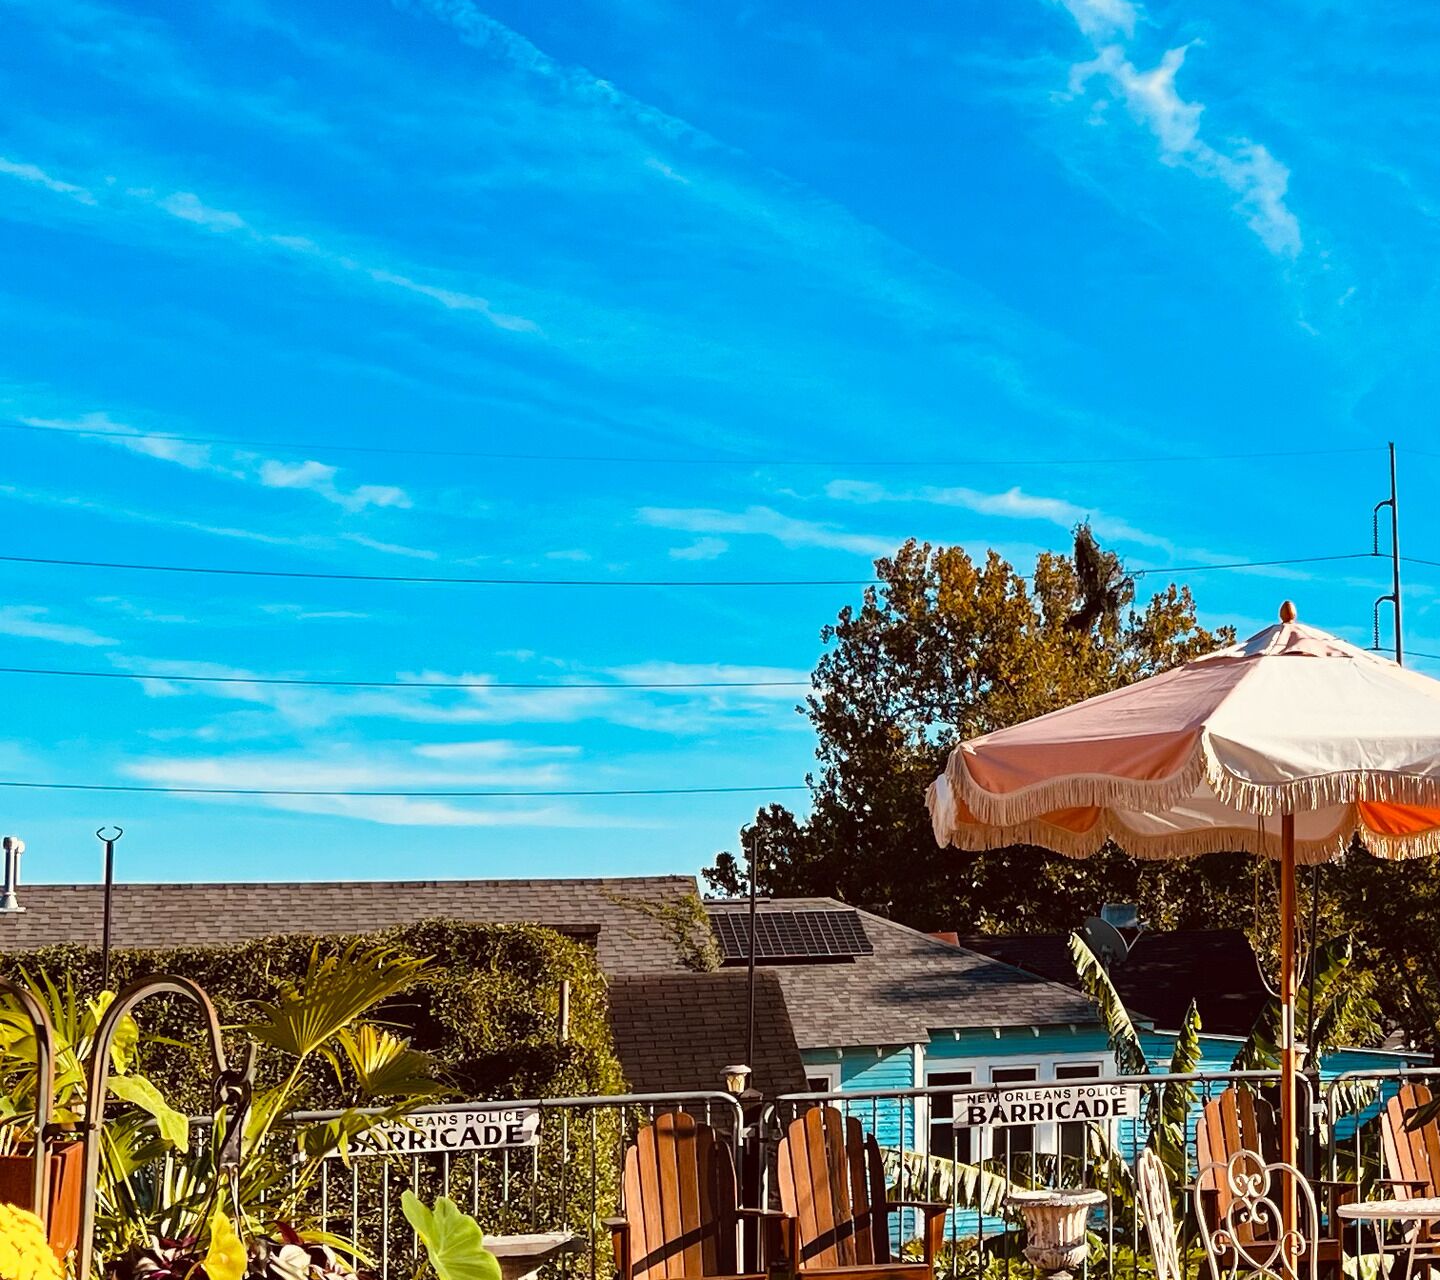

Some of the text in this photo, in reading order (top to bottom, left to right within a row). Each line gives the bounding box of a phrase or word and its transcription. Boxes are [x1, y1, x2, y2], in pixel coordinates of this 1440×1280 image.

[967, 1086, 1128, 1104] NEW ORLEANS POLICE
[465, 1111, 525, 1124] POLICE
[967, 1097, 1128, 1126] BARRICADE
